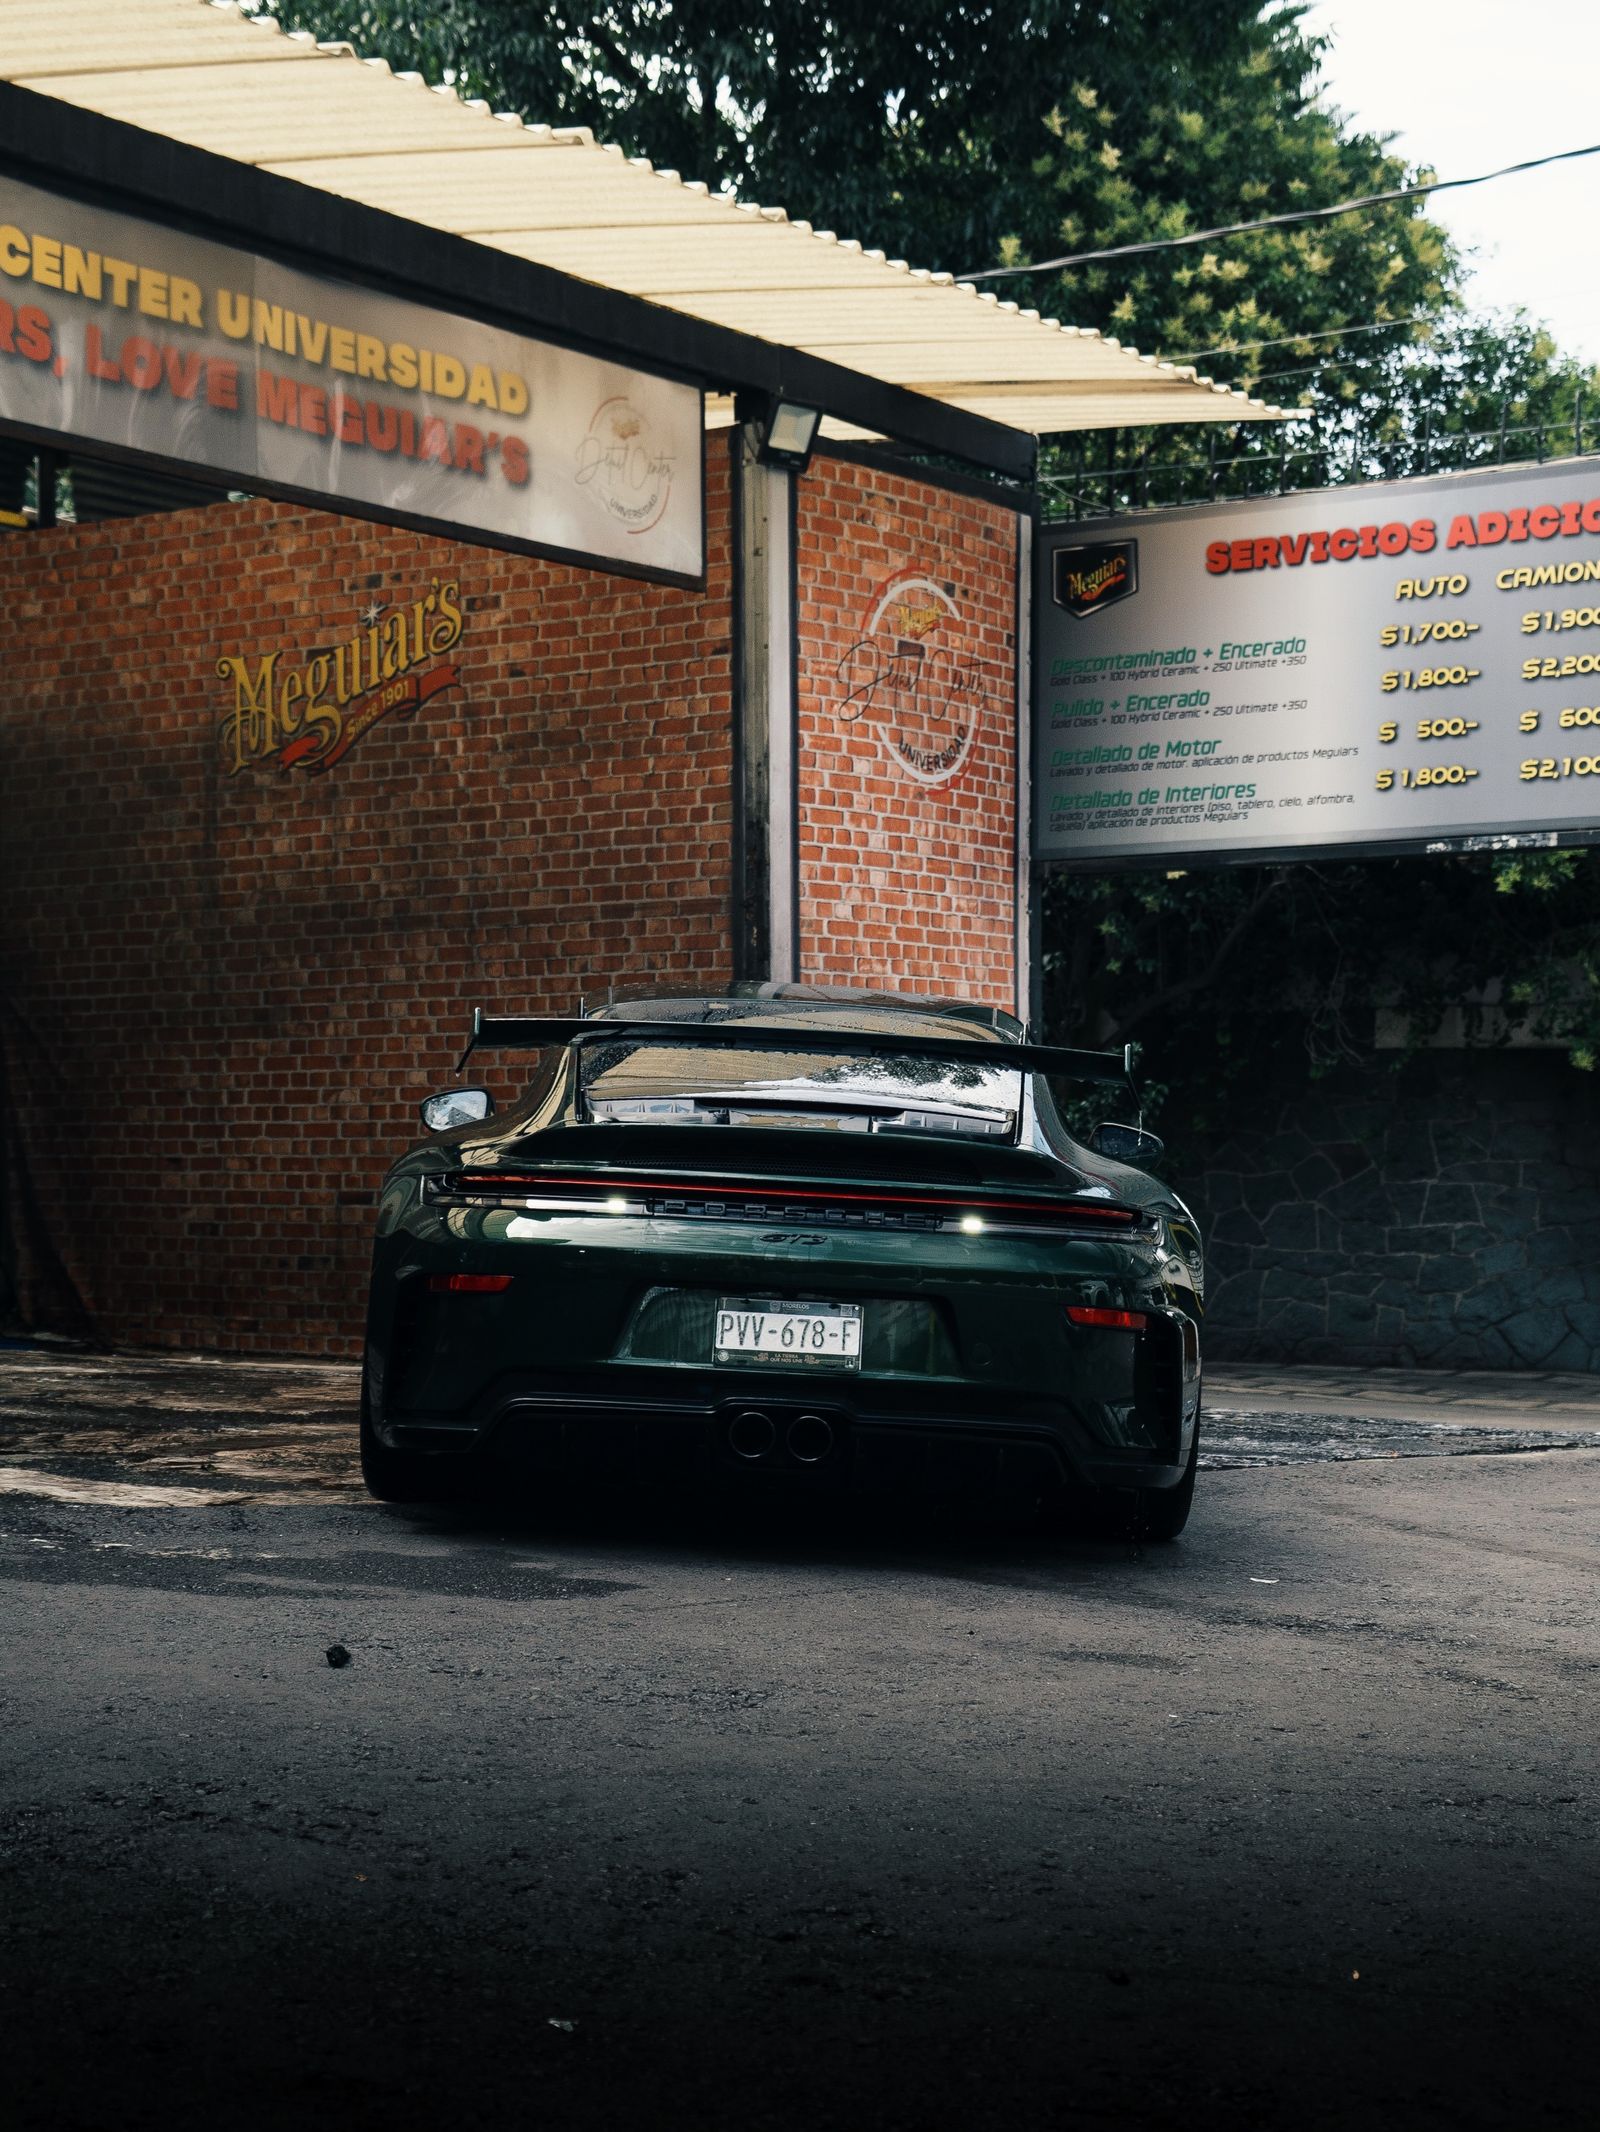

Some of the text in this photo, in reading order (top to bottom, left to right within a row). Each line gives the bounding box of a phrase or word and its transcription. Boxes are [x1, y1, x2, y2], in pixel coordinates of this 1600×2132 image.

[0, 224, 528, 415] CENTER UNIVERSIDAD
[86, 323, 238, 410] LOVE
[257, 369, 529, 484] MEGUIAR'S
[609, 494, 658, 520] UNIVERSIDAD
[1205, 519, 1437, 574] SERVICIOS
[1395, 560, 1600, 600] AUTO CAMION
[1052, 637, 1306, 675] Descontaminado + Encerado
[1073, 674, 1097, 685] Class
[1110, 672, 1126, 681] 100
[1128, 668, 1159, 681] Hybrid
[1161, 664, 1200, 677] Ceramic
[1212, 662, 1232, 673] 250
[1235, 658, 1278, 670] Ultimate
[216, 577, 463, 777] Meguiar's
[347, 679, 409, 742] Since 1901
[1052, 689, 1211, 718] Pulido + Encerado
[1074, 717, 1098, 728] Class
[1111, 714, 1127, 725] 100
[1129, 711, 1159, 725] Hybrid
[1162, 708, 1200, 721] Ceramic
[1213, 706, 1233, 717] 250
[1236, 702, 1278, 715] Ultimate
[898, 726, 967, 770] UNIVERSIDAD
[1051, 766, 1084, 777] Lavado
[1086, 767, 1092, 777] y
[1095, 763, 1138, 775] detallado
[1141, 761, 1154, 771] de
[1191, 755, 1239, 768] aplicación
[1242, 753, 1254, 764] de
[1256, 750, 1308, 764] productos
[1312, 746, 1359, 759] Meguiars
[1052, 739, 1222, 767] Detallado de Motor
[1050, 811, 1083, 822] Lavado
[1086, 811, 1092, 821] y
[1095, 807, 1138, 820] detallado
[1141, 806, 1153, 816] de
[1156, 804, 1205, 814] interiores
[1238, 800, 1276, 811] tablero,
[1306, 794, 1355, 806] alfombra,
[1051, 783, 1256, 812] Detallado de Interiores
[1087, 819, 1133, 831] aplicación
[1135, 817, 1148, 827] de
[1150, 814, 1200, 827] productos
[1203, 811, 1248, 823] Meguiars
[664, 1200, 926, 1225] PORSCHE
[719, 1314, 857, 1351] PVV-678-F
